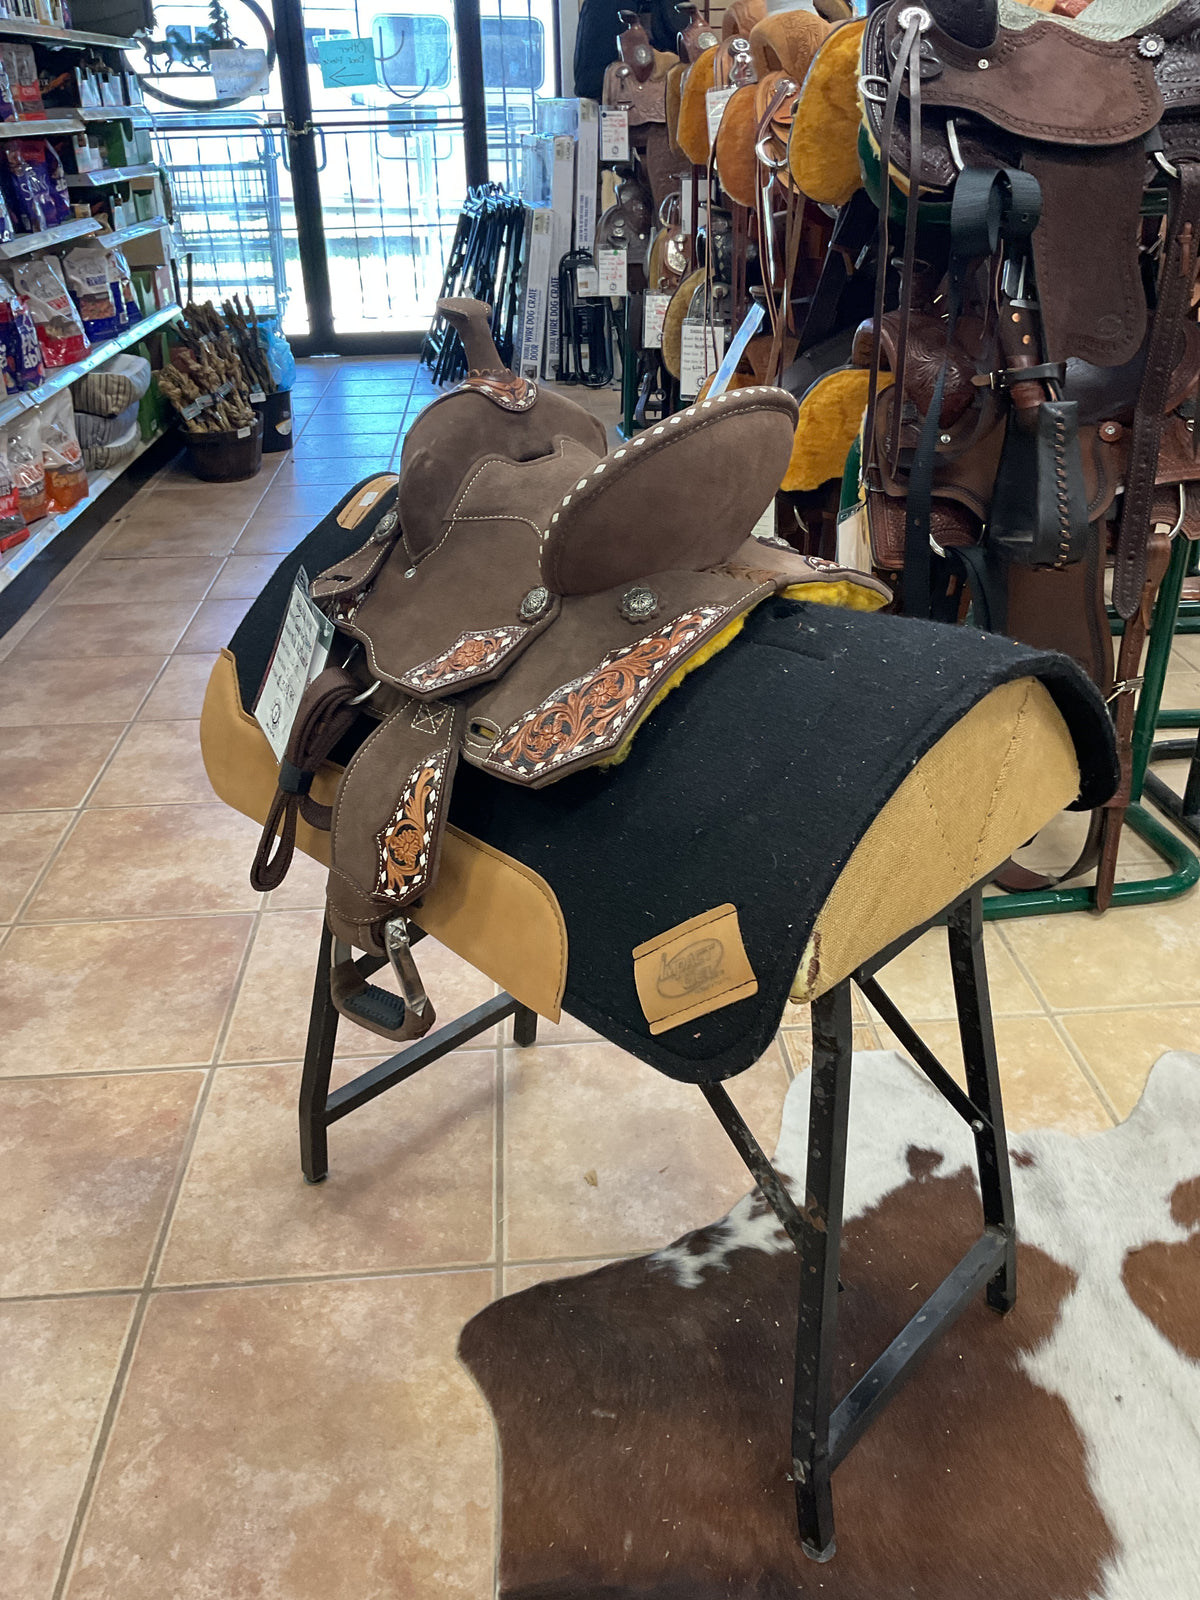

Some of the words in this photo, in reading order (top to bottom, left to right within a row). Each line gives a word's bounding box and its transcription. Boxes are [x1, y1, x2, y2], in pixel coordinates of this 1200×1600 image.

[528, 288, 537, 309] CRATE
[550, 301, 559, 316] DOG
[526, 310, 535, 325] DOG
[525, 325, 534, 342] WIRE
[550, 318, 559, 337] WIRE
[530, 344, 539, 361] DOOR
